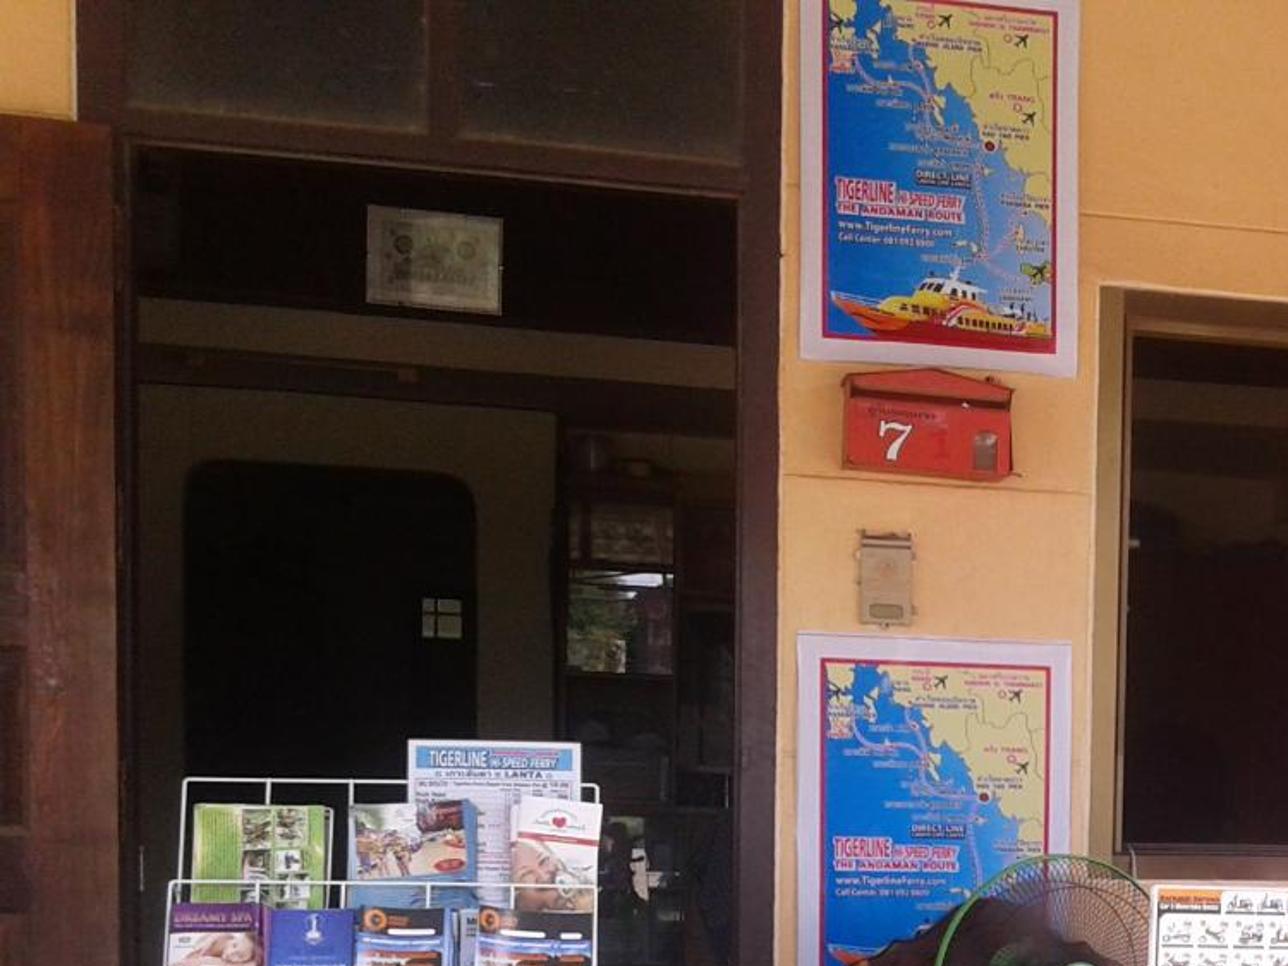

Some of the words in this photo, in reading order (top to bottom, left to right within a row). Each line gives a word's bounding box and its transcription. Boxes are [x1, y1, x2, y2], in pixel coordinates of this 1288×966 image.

[837, 178, 895, 204] TIGERLINE
[837, 202, 856, 213] THE
[862, 205, 923, 219] ANDAMAN
[878, 420, 913, 461] 7
[430, 750, 488, 768] TIGERLINE
[529, 758, 559, 769] FERRY
[505, 771, 543, 779] LANTA
[834, 838, 892, 859] TIGERLINE
[859, 861, 918, 871] ANDAMAN
